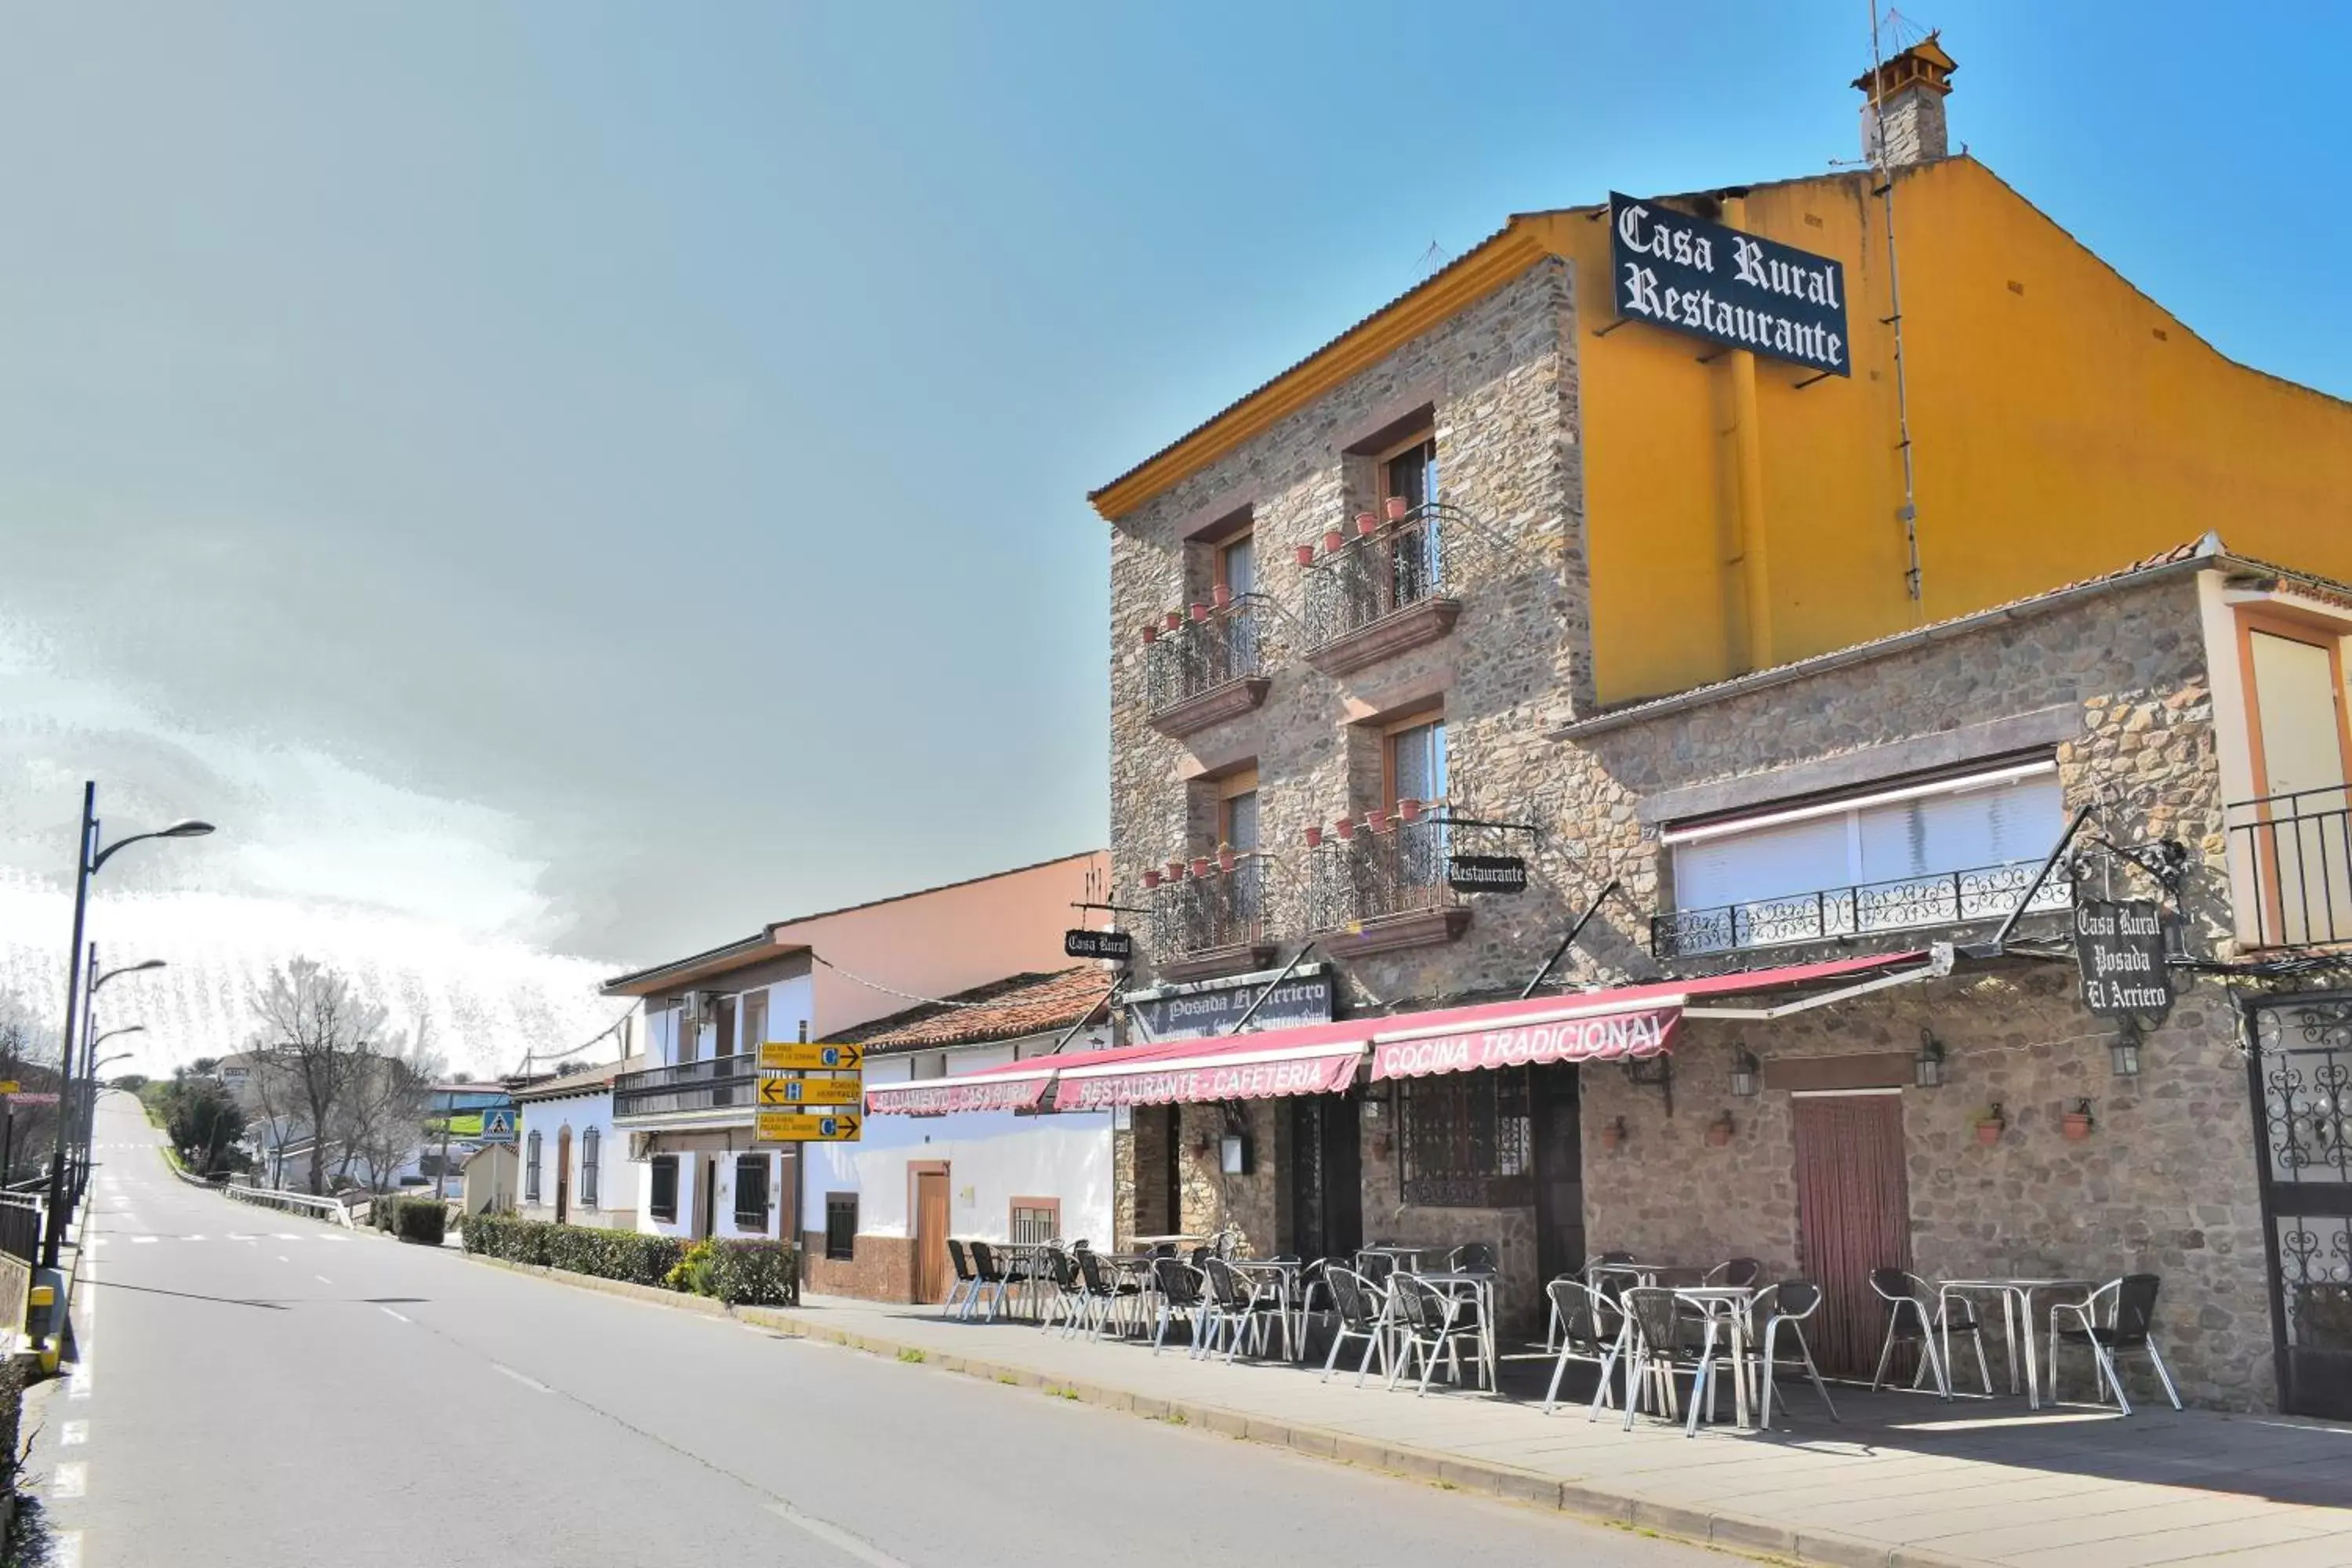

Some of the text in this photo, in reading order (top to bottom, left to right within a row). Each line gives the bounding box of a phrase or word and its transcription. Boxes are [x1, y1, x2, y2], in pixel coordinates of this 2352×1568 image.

[1618, 205, 1840, 310] Casa Rural
[1624, 262, 1842, 366] Restaurante
[1450, 862, 1523, 882] Restaurante
[2078, 908, 2161, 935] Casa Rural
[1069, 935, 1128, 953] Casa Rural
[2094, 944, 2151, 978] Posada
[1168, 995, 1228, 1022] Posada
[2087, 981, 2166, 1008] El Arriero
[1383, 1014, 1662, 1072] COCINA TRADICIONAL
[1080, 1073, 1198, 1102] RESTAURANTE
[1214, 1062, 1321, 1091] CAFETERIA
